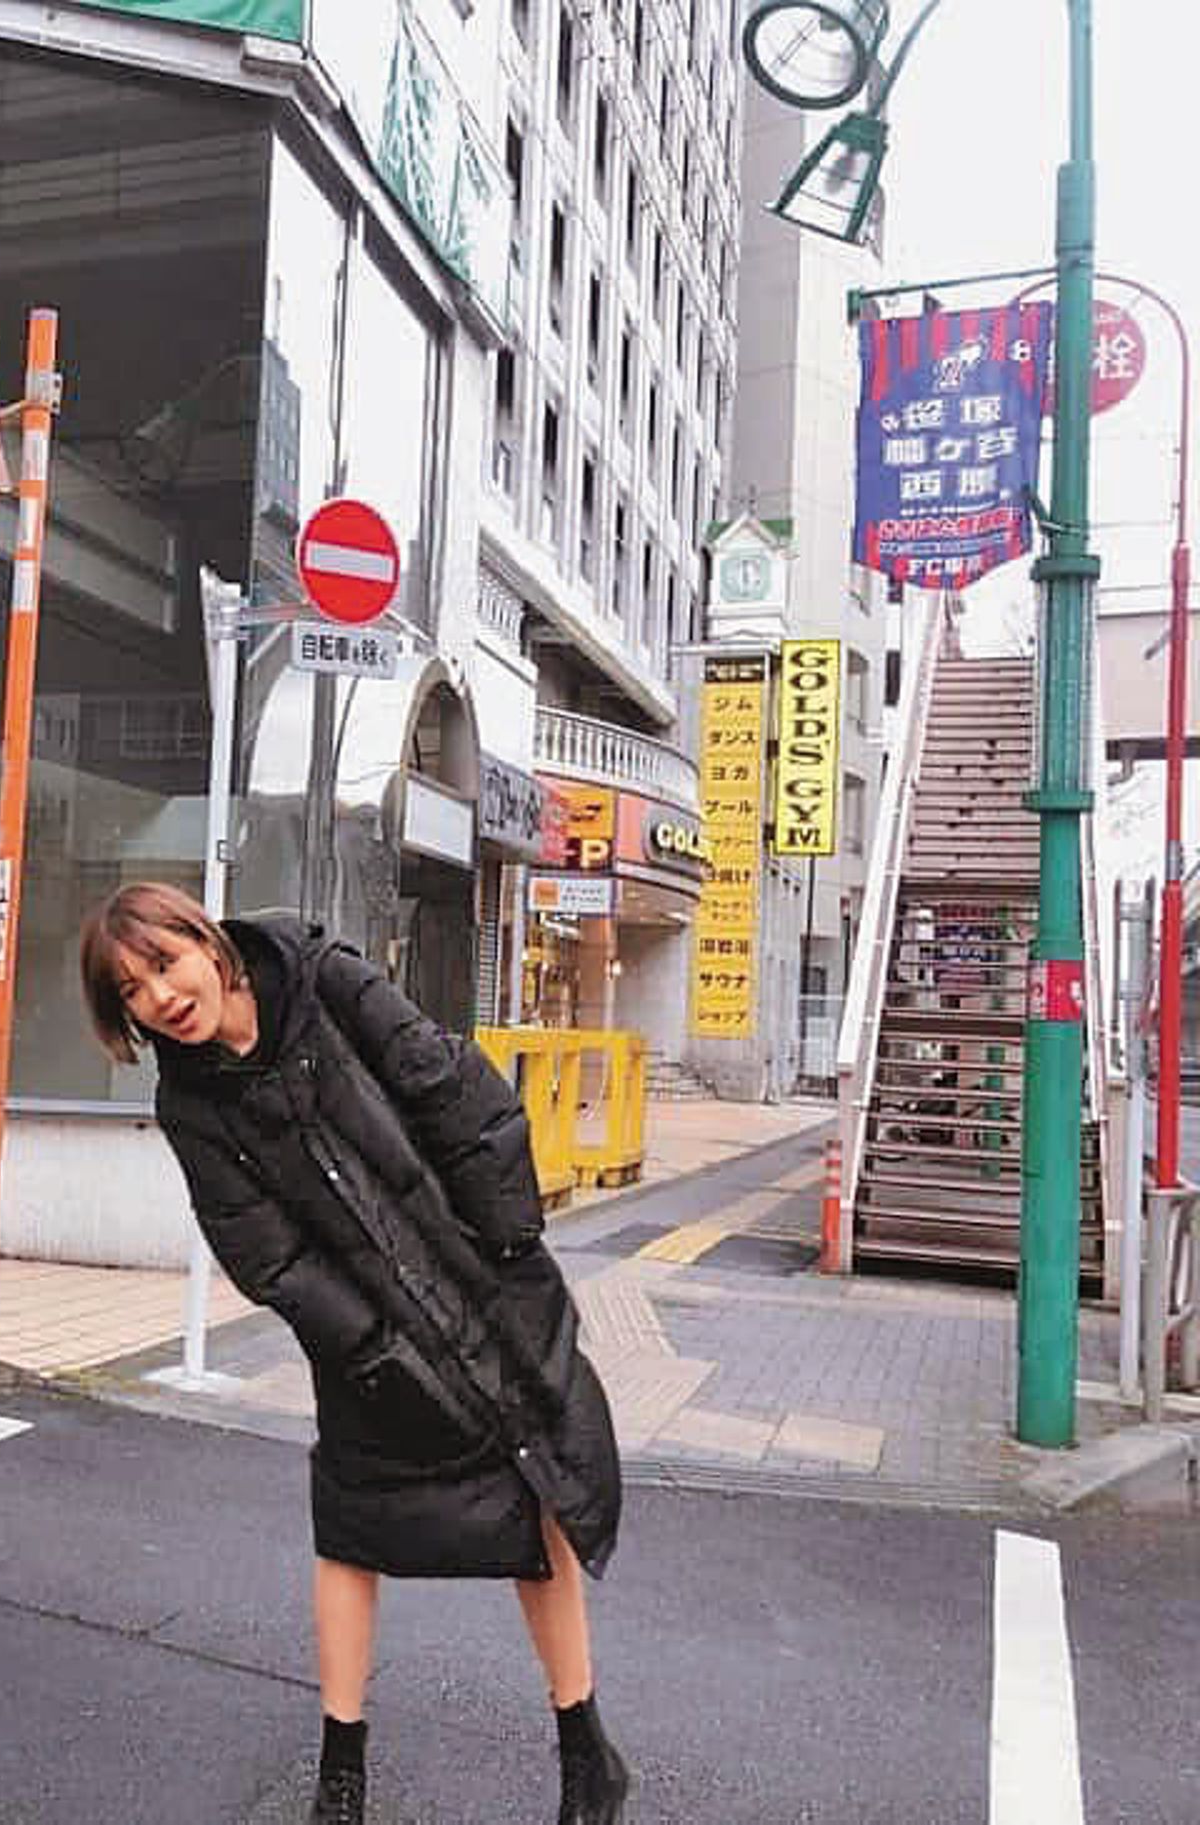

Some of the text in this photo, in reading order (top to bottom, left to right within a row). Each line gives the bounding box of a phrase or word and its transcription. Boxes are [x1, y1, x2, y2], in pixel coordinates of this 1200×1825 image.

[711, 766, 749, 782] ヨガ
[784, 778, 828, 848] GYM
[699, 973, 747, 990] サウナ
